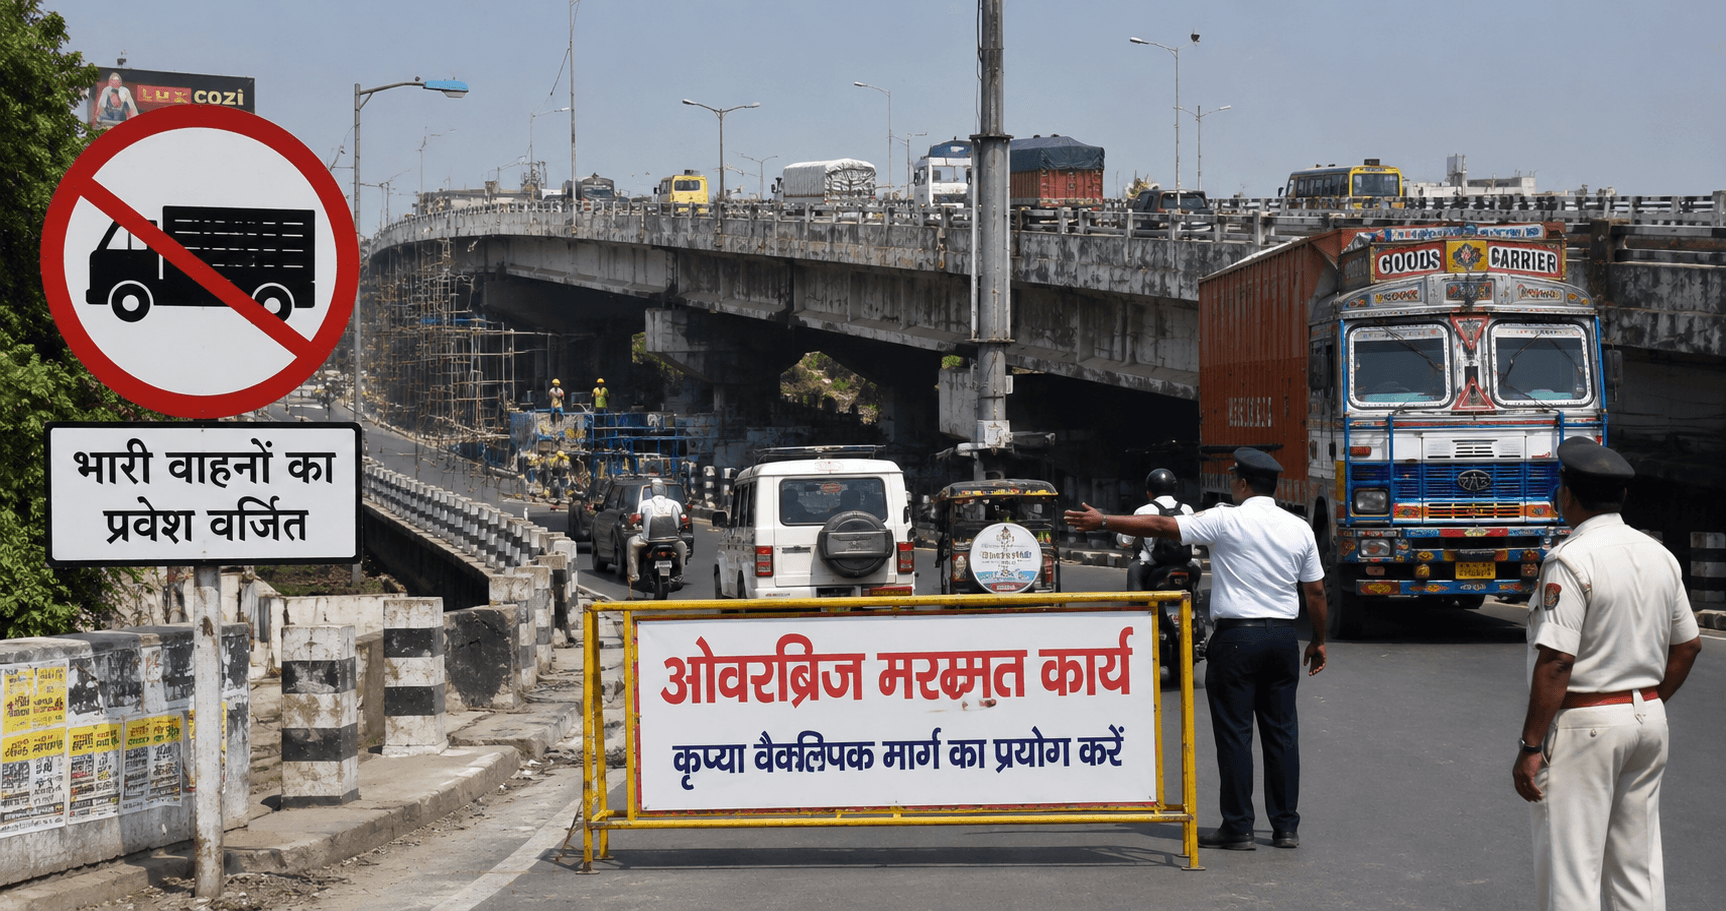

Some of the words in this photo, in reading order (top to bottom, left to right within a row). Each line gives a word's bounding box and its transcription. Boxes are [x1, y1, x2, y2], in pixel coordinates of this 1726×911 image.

[1378, 248, 1441, 274] GOODS
[1491, 246, 1557, 274] CARRIER
[73, 437, 154, 485] भारी
[164, 437, 274, 489] वाहनों
[284, 452, 337, 485] का
[102, 495, 196, 545] प्रवेश
[206, 495, 310, 542] वर्जित
[660, 633, 866, 708] ओवरब्रिज
[1038, 626, 1134, 697] कार्य
[671, 743, 747, 791] कृप्या
[881, 727, 942, 771] मार्ग
[947, 739, 987, 769] का
[992, 725, 1072, 774] प्रयोग
[1077, 723, 1125, 767] करें
